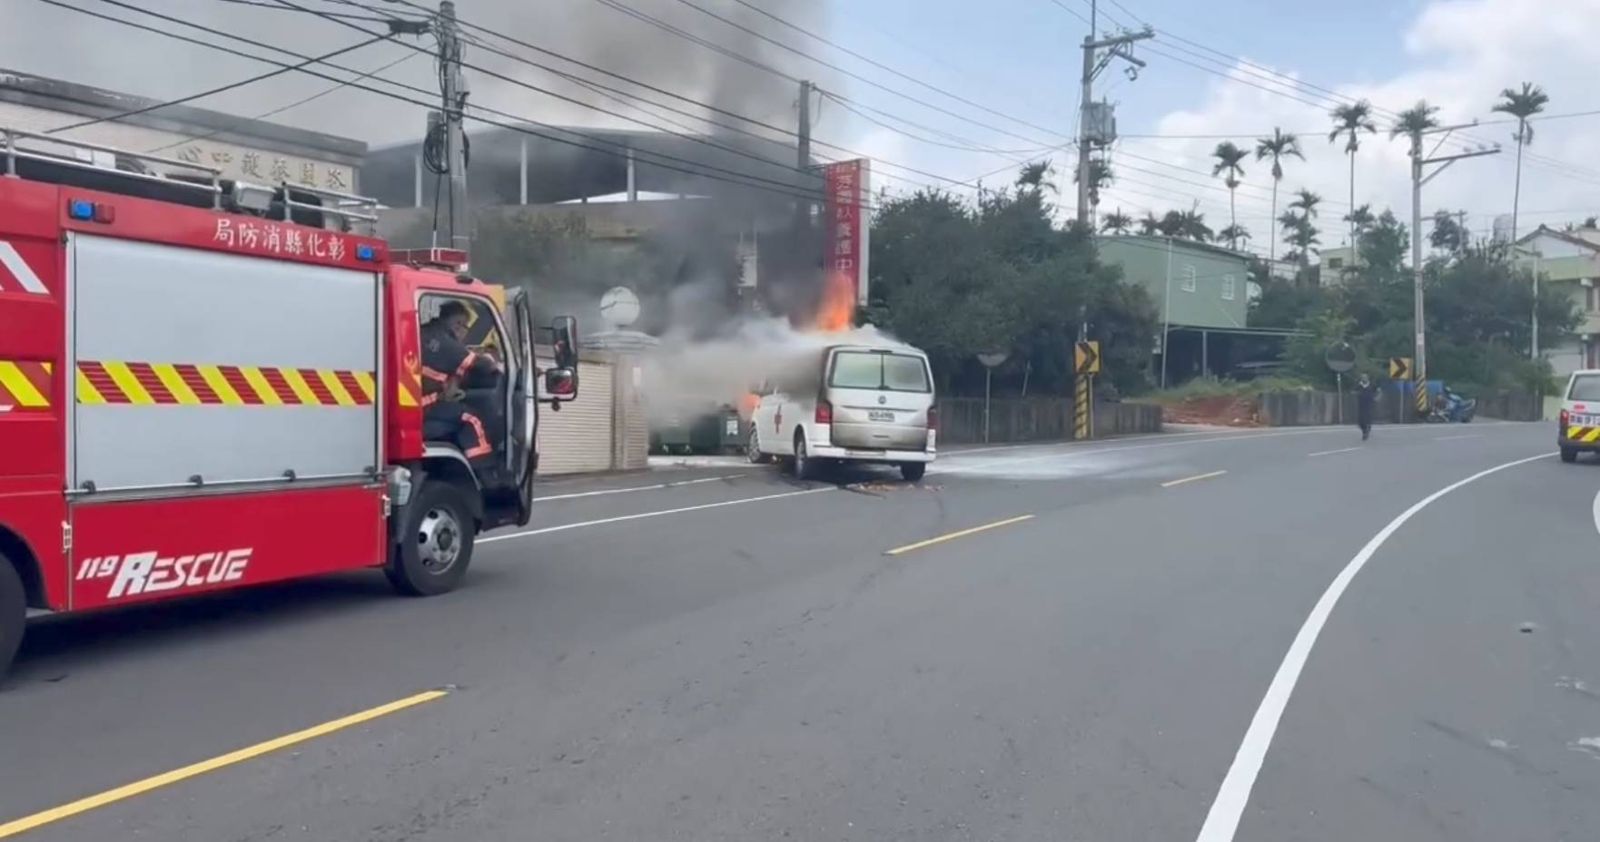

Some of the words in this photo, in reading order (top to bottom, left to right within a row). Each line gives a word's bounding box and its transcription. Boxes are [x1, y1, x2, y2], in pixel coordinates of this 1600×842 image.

[213, 218, 346, 261] 彰化縣消防局
[76, 555, 120, 581] 119
[107, 547, 253, 599] RESCUE
